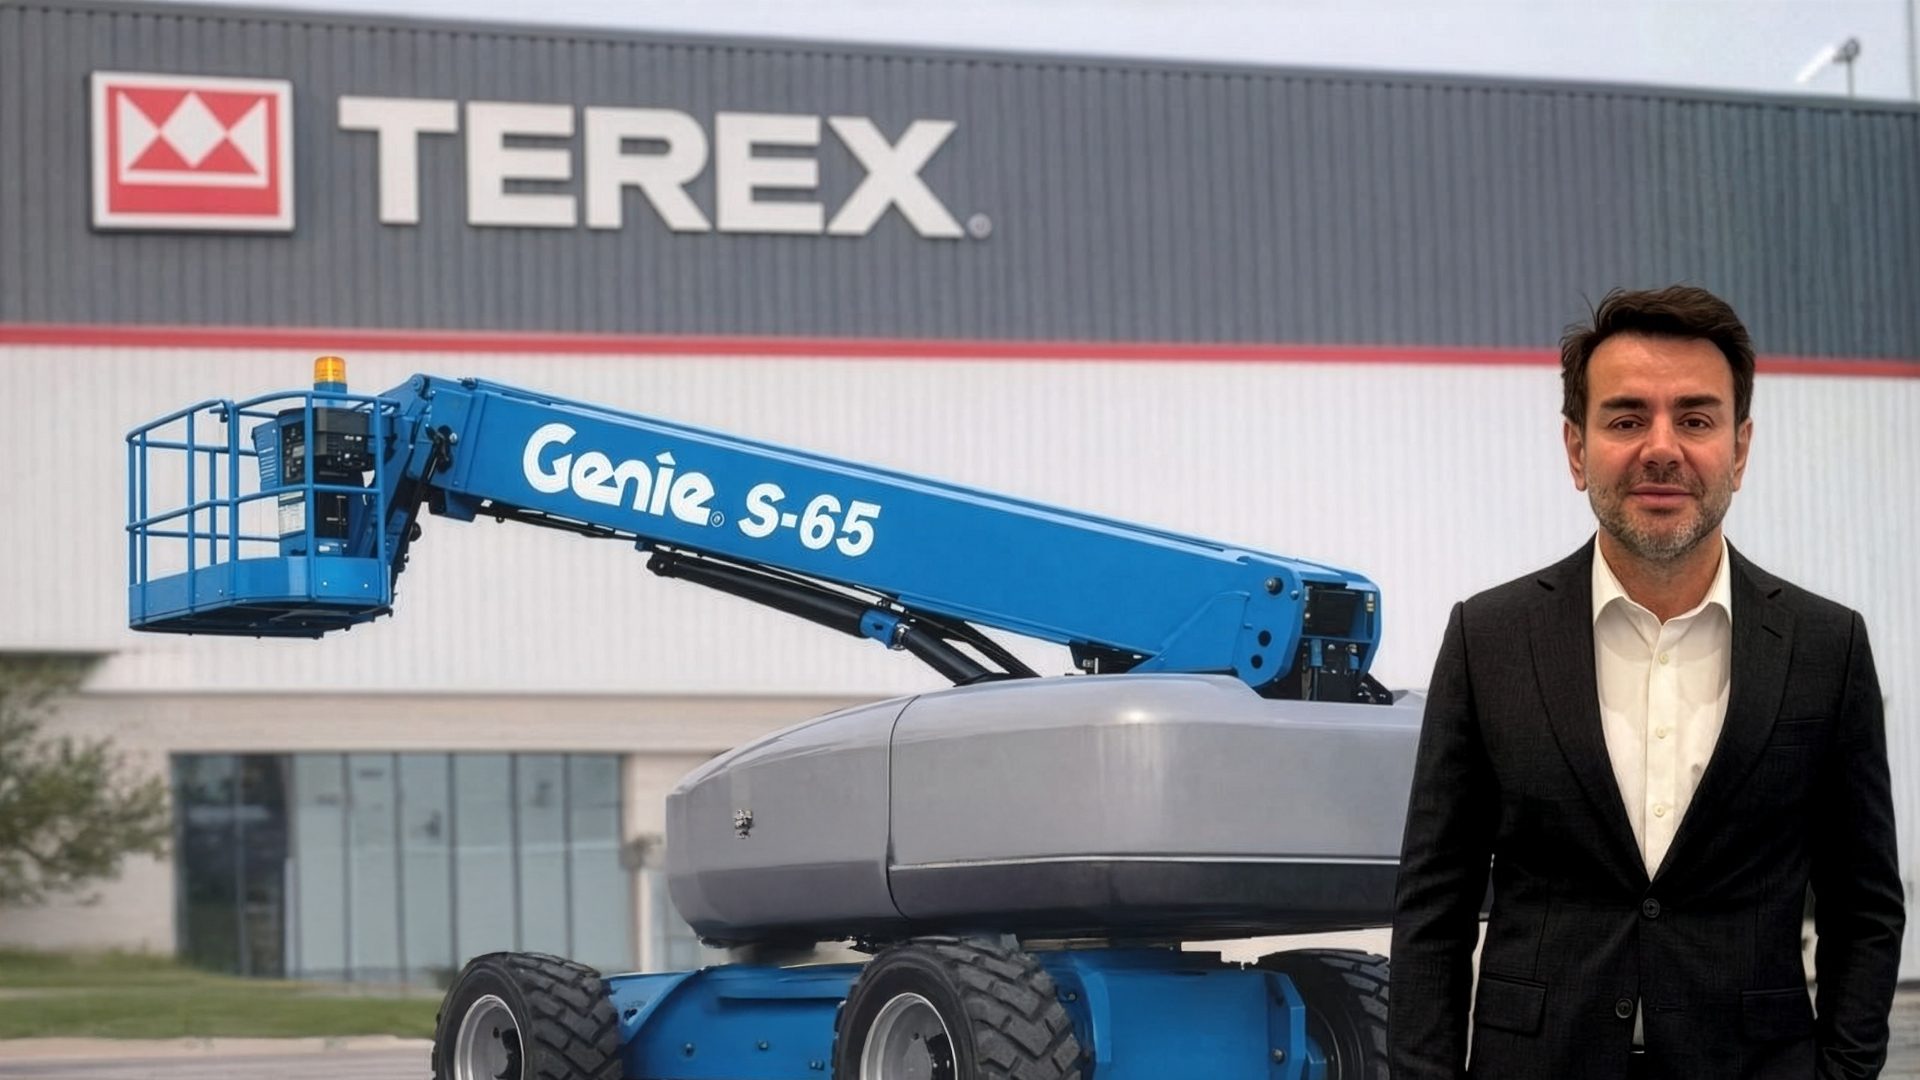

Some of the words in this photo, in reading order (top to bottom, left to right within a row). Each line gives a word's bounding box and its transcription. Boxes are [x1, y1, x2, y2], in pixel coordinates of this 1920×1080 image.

[338, 96, 965, 238] TEREX
[523, 423, 715, 526] Genie
[738, 483, 881, 556] S-65
